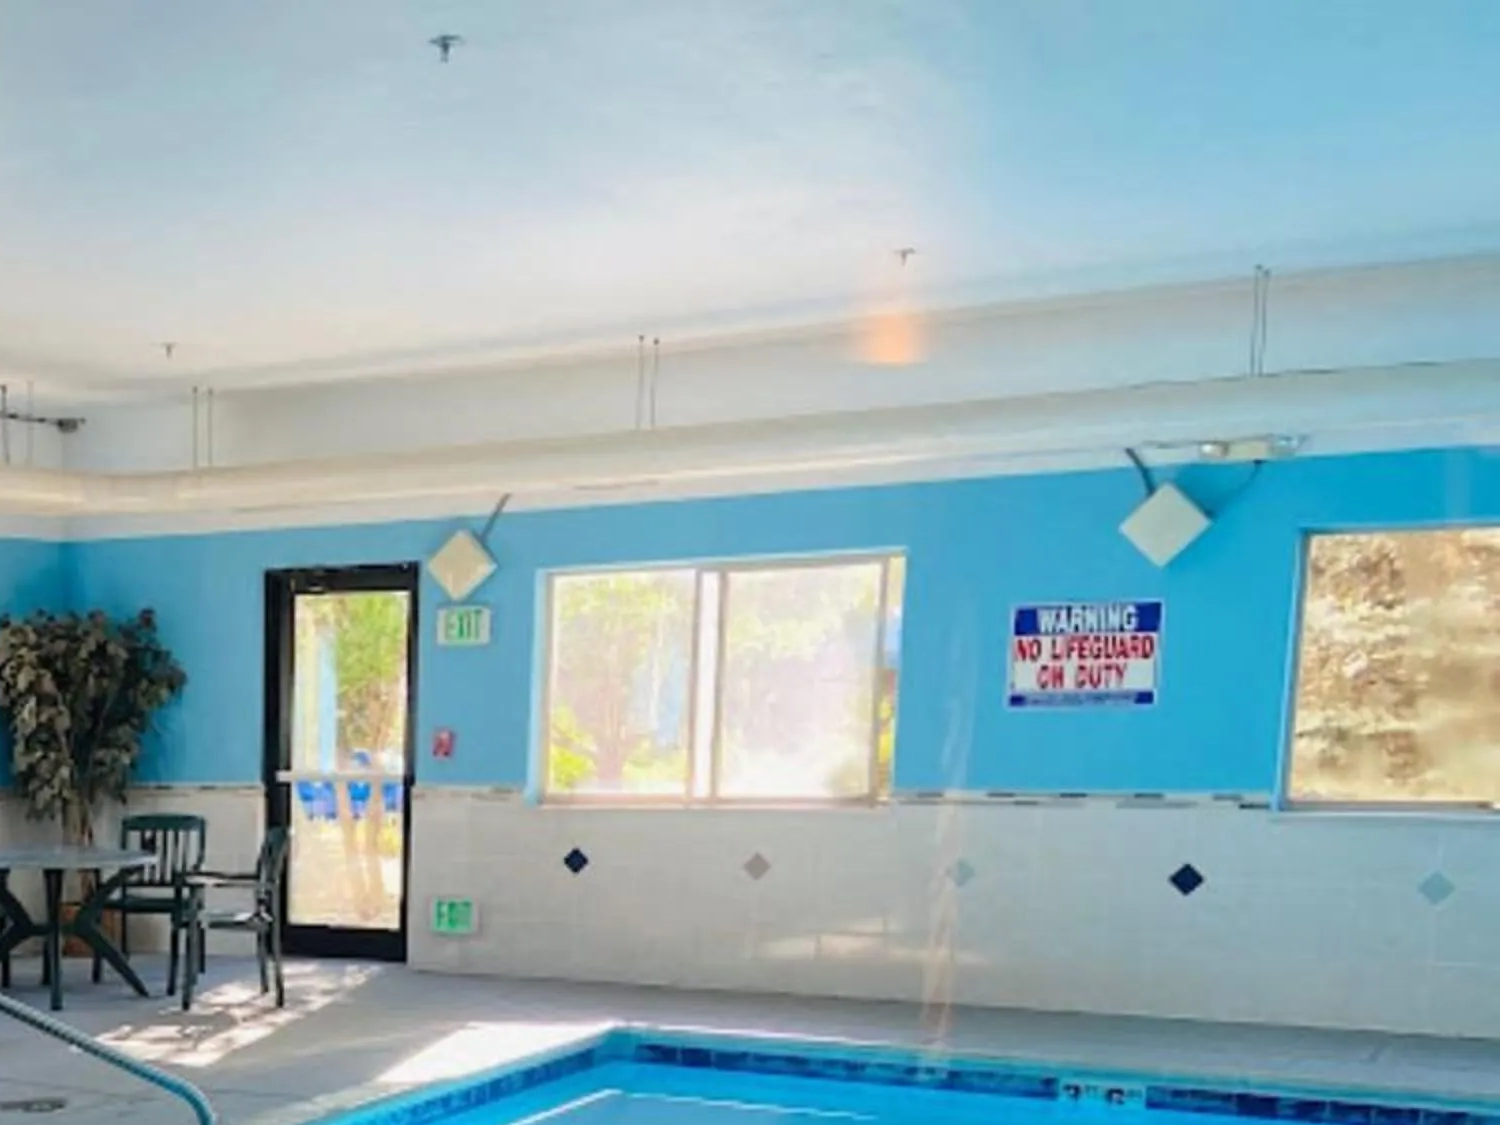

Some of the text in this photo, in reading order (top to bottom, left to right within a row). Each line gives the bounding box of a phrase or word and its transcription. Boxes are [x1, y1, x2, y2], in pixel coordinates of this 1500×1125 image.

[444, 609, 483, 641] EXIT
[1039, 605, 1138, 633] WARNING
[1016, 635, 1155, 661] NO LIFEGUARD
[1037, 663, 1128, 689] ON DUTY
